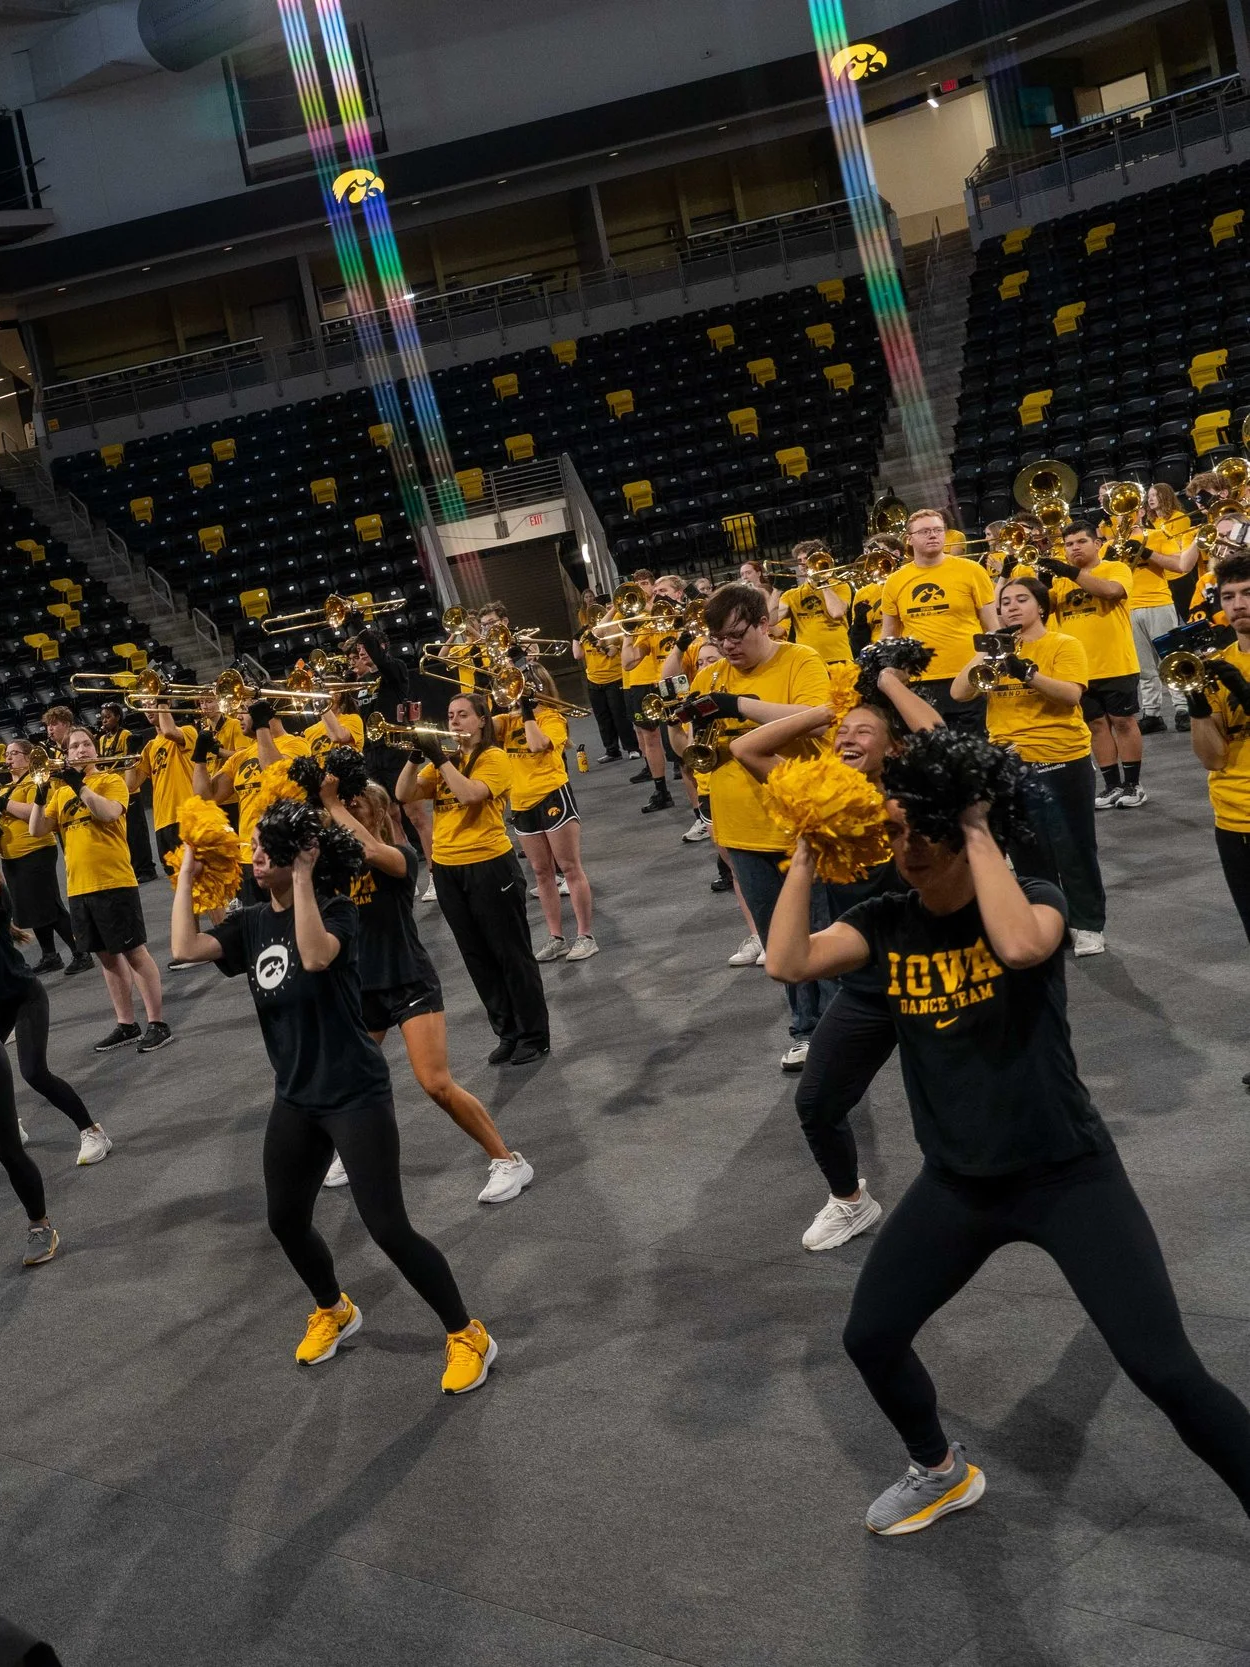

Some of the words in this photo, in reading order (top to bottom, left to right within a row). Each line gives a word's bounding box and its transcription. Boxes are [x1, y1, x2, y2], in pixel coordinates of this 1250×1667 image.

[529, 514, 543, 526] EXIT
[888, 936, 1003, 996] IOWA
[900, 996, 949, 1015] DANCE
[951, 982, 995, 1009] TEAM
